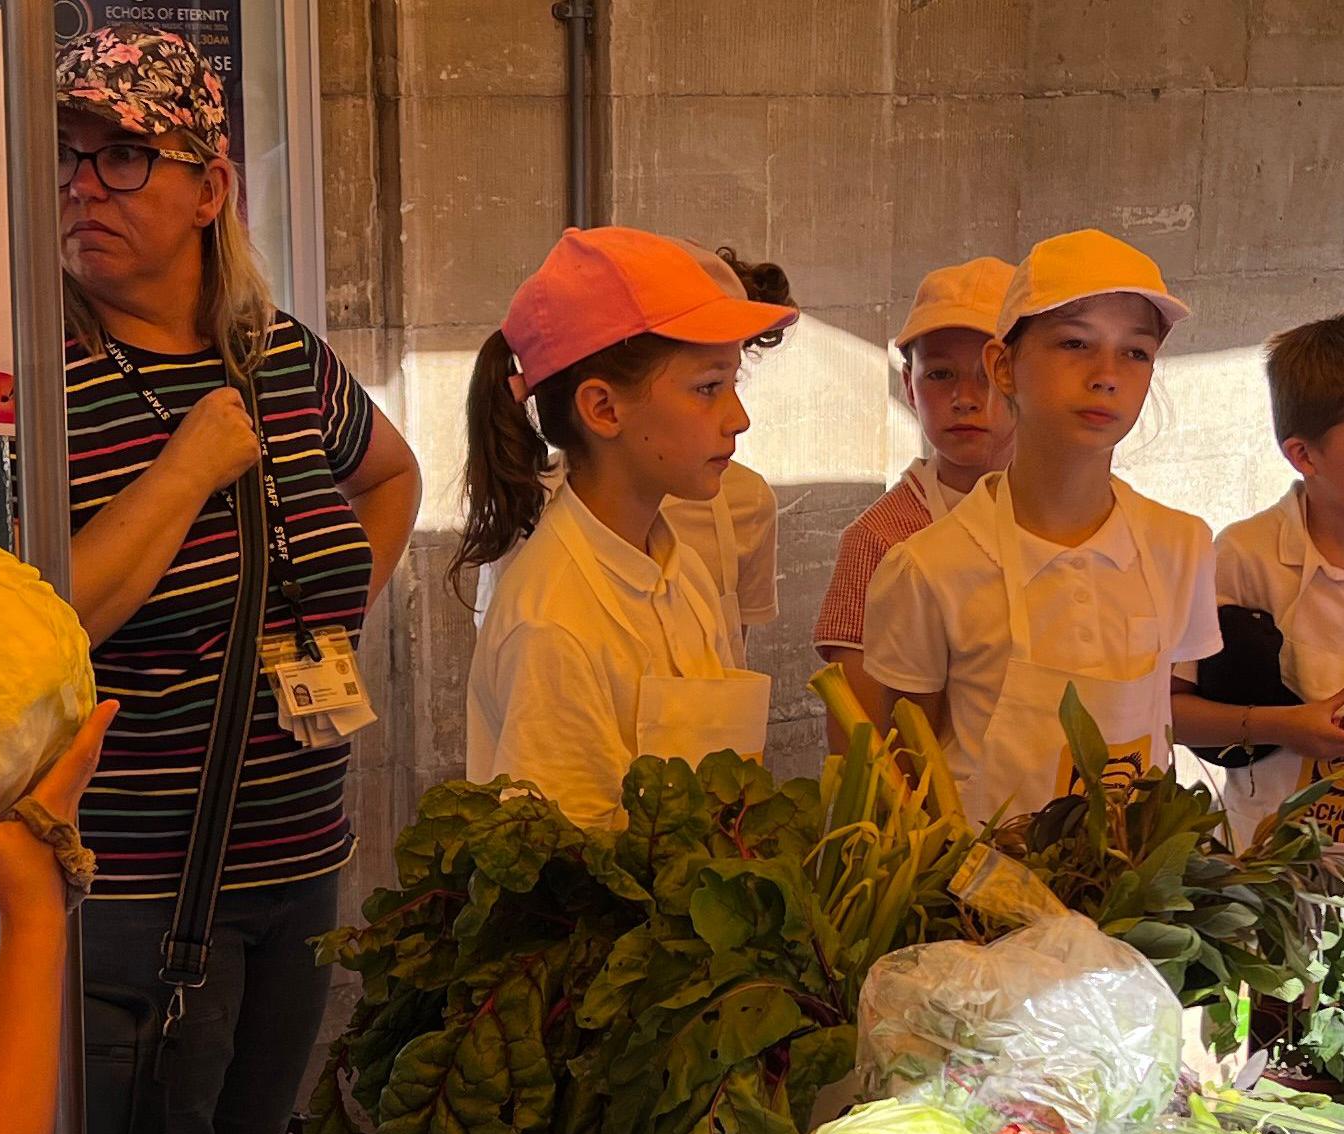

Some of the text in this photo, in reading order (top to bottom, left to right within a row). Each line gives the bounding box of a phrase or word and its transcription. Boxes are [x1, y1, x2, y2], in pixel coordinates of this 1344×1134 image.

[105, 5, 229, 22] ECHOES OF ETERNITY
[105, 342, 133, 375] STAFF
[142, 388, 170, 421] STAFF
[263, 474, 279, 508] STAFF
[273, 526, 289, 561] STAFF
